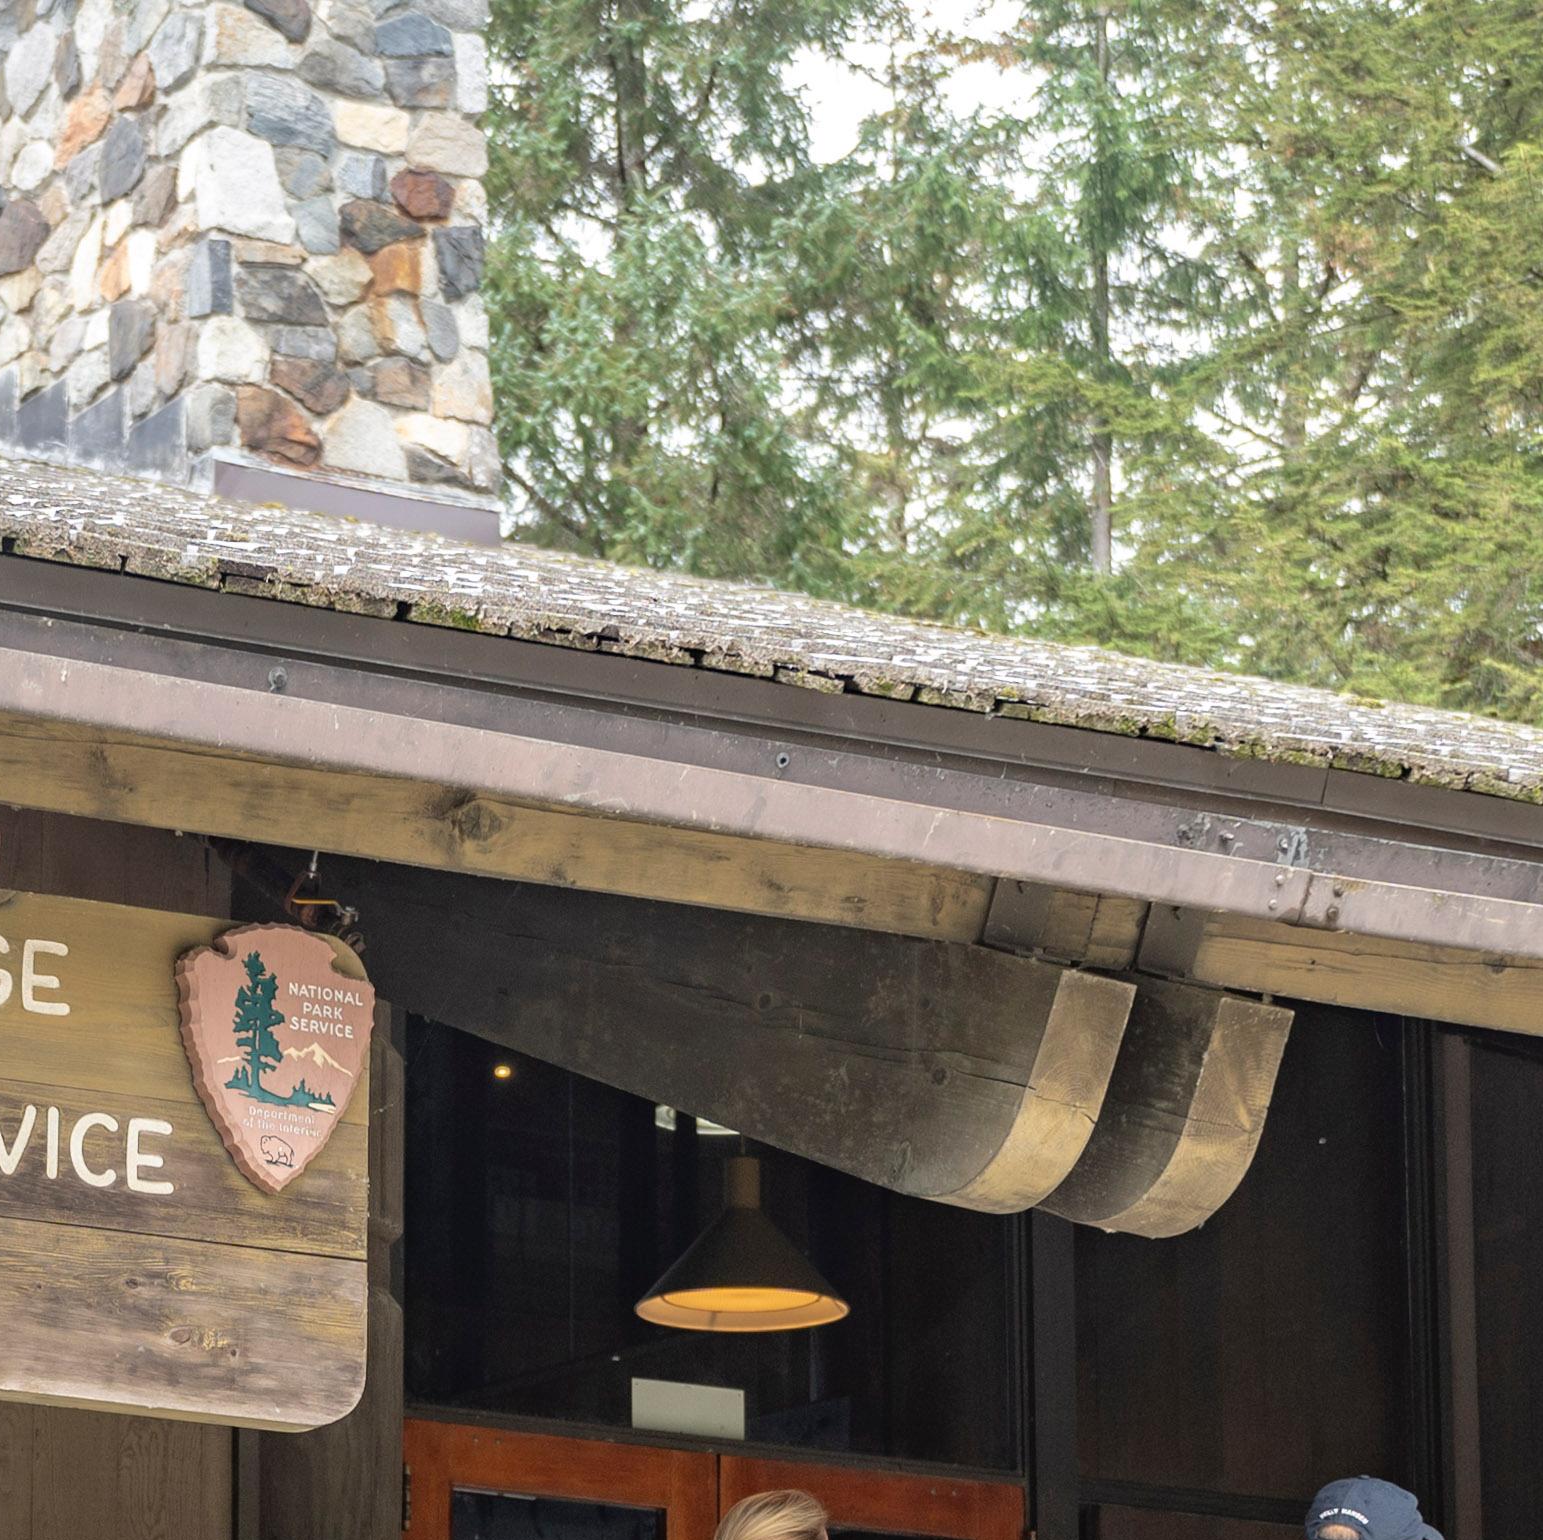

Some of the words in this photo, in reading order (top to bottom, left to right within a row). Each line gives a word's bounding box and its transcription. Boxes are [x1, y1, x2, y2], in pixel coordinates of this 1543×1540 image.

[288, 982, 364, 1006] NATIONAL
[303, 1002, 344, 1020] PARK
[289, 1017, 354, 1039] SERVICE
